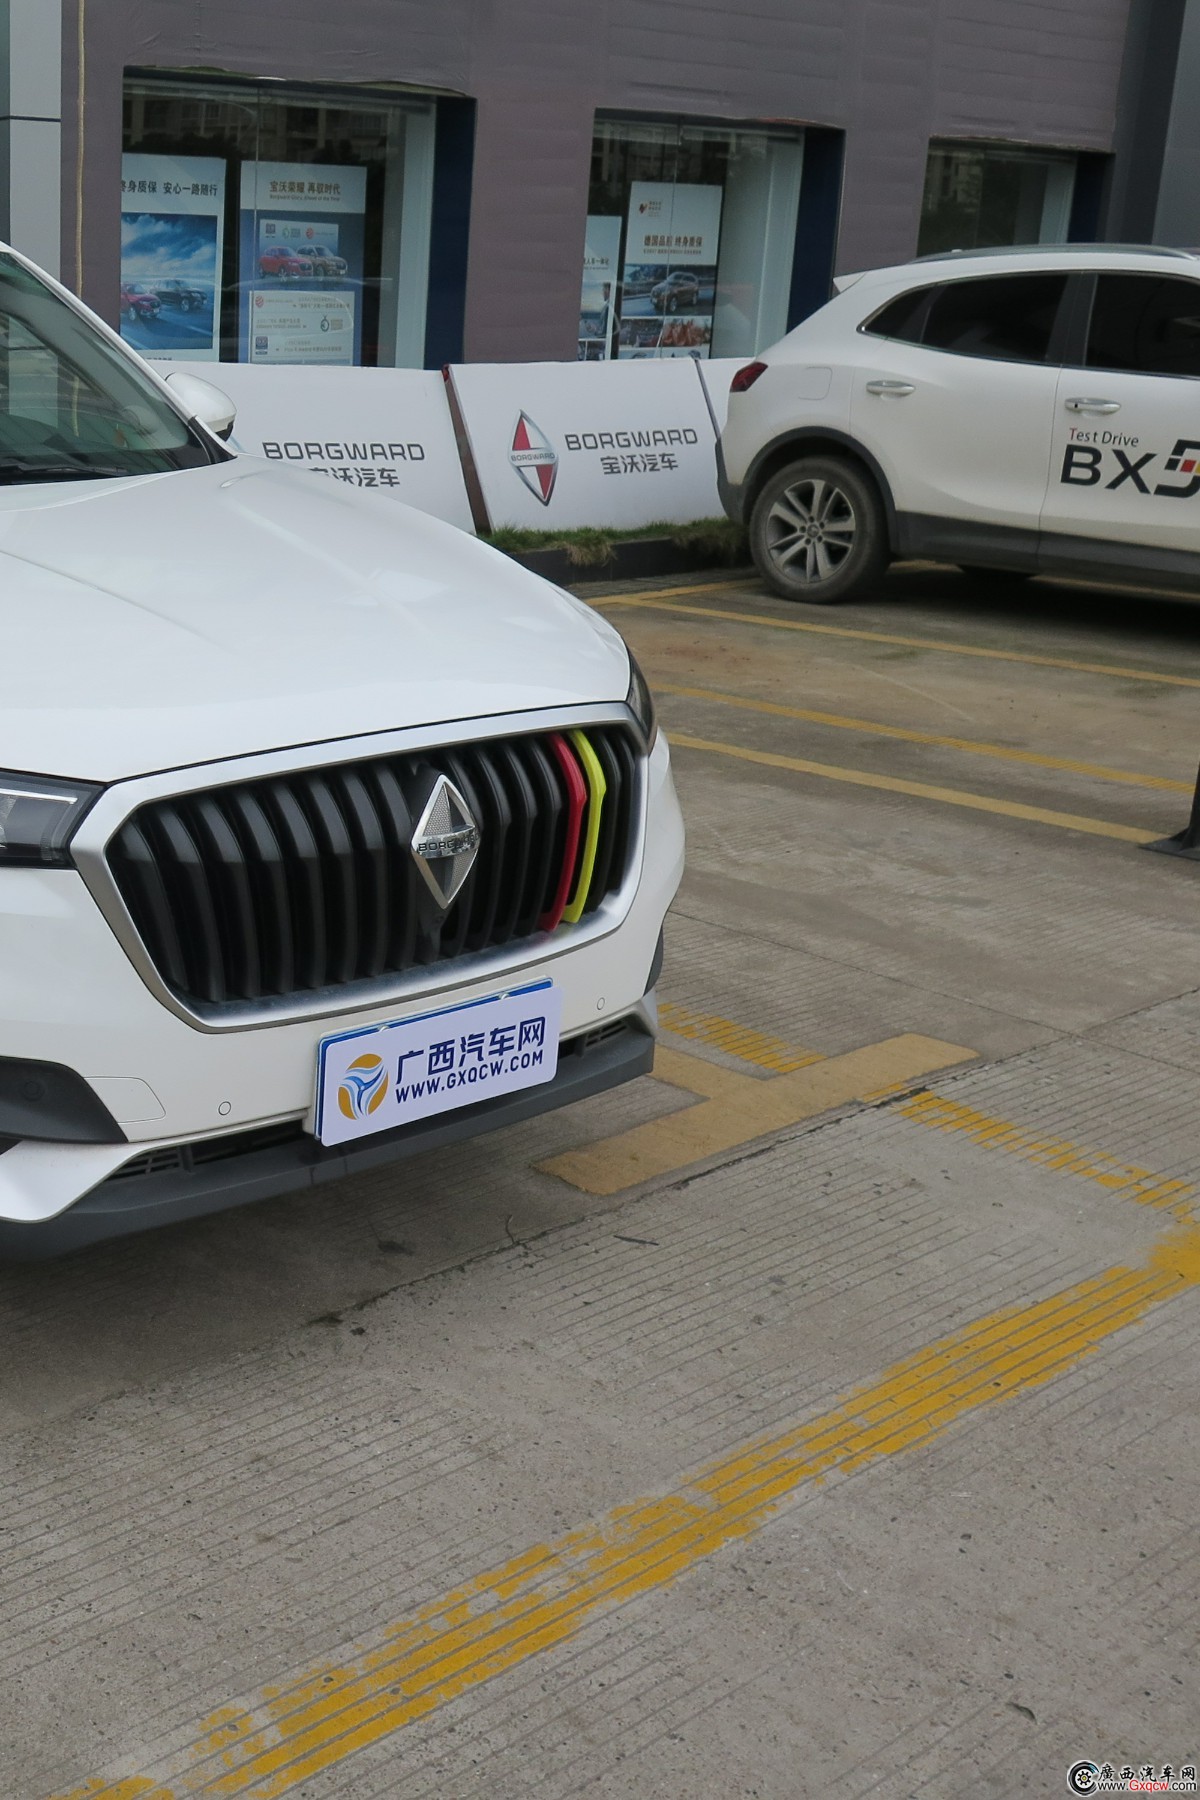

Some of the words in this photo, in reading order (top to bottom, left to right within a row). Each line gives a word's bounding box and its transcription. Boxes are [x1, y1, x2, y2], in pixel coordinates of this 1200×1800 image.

[163, 181, 218, 196] 安心一路随行
[270, 180, 305, 193] 宝沃荣耀
[564, 428, 698, 451] BORGWARD
[1069, 428, 1098, 442] Test
[1101, 431, 1139, 447] Drive
[262, 442, 425, 461] BORGWARD
[511, 452, 555, 462] BORGWARD
[600, 453, 679, 475] 宝沃汽车
[396, 1016, 546, 1085] 广西汽车网
[395, 1050, 543, 1103] WWW.GXQCW.COM
